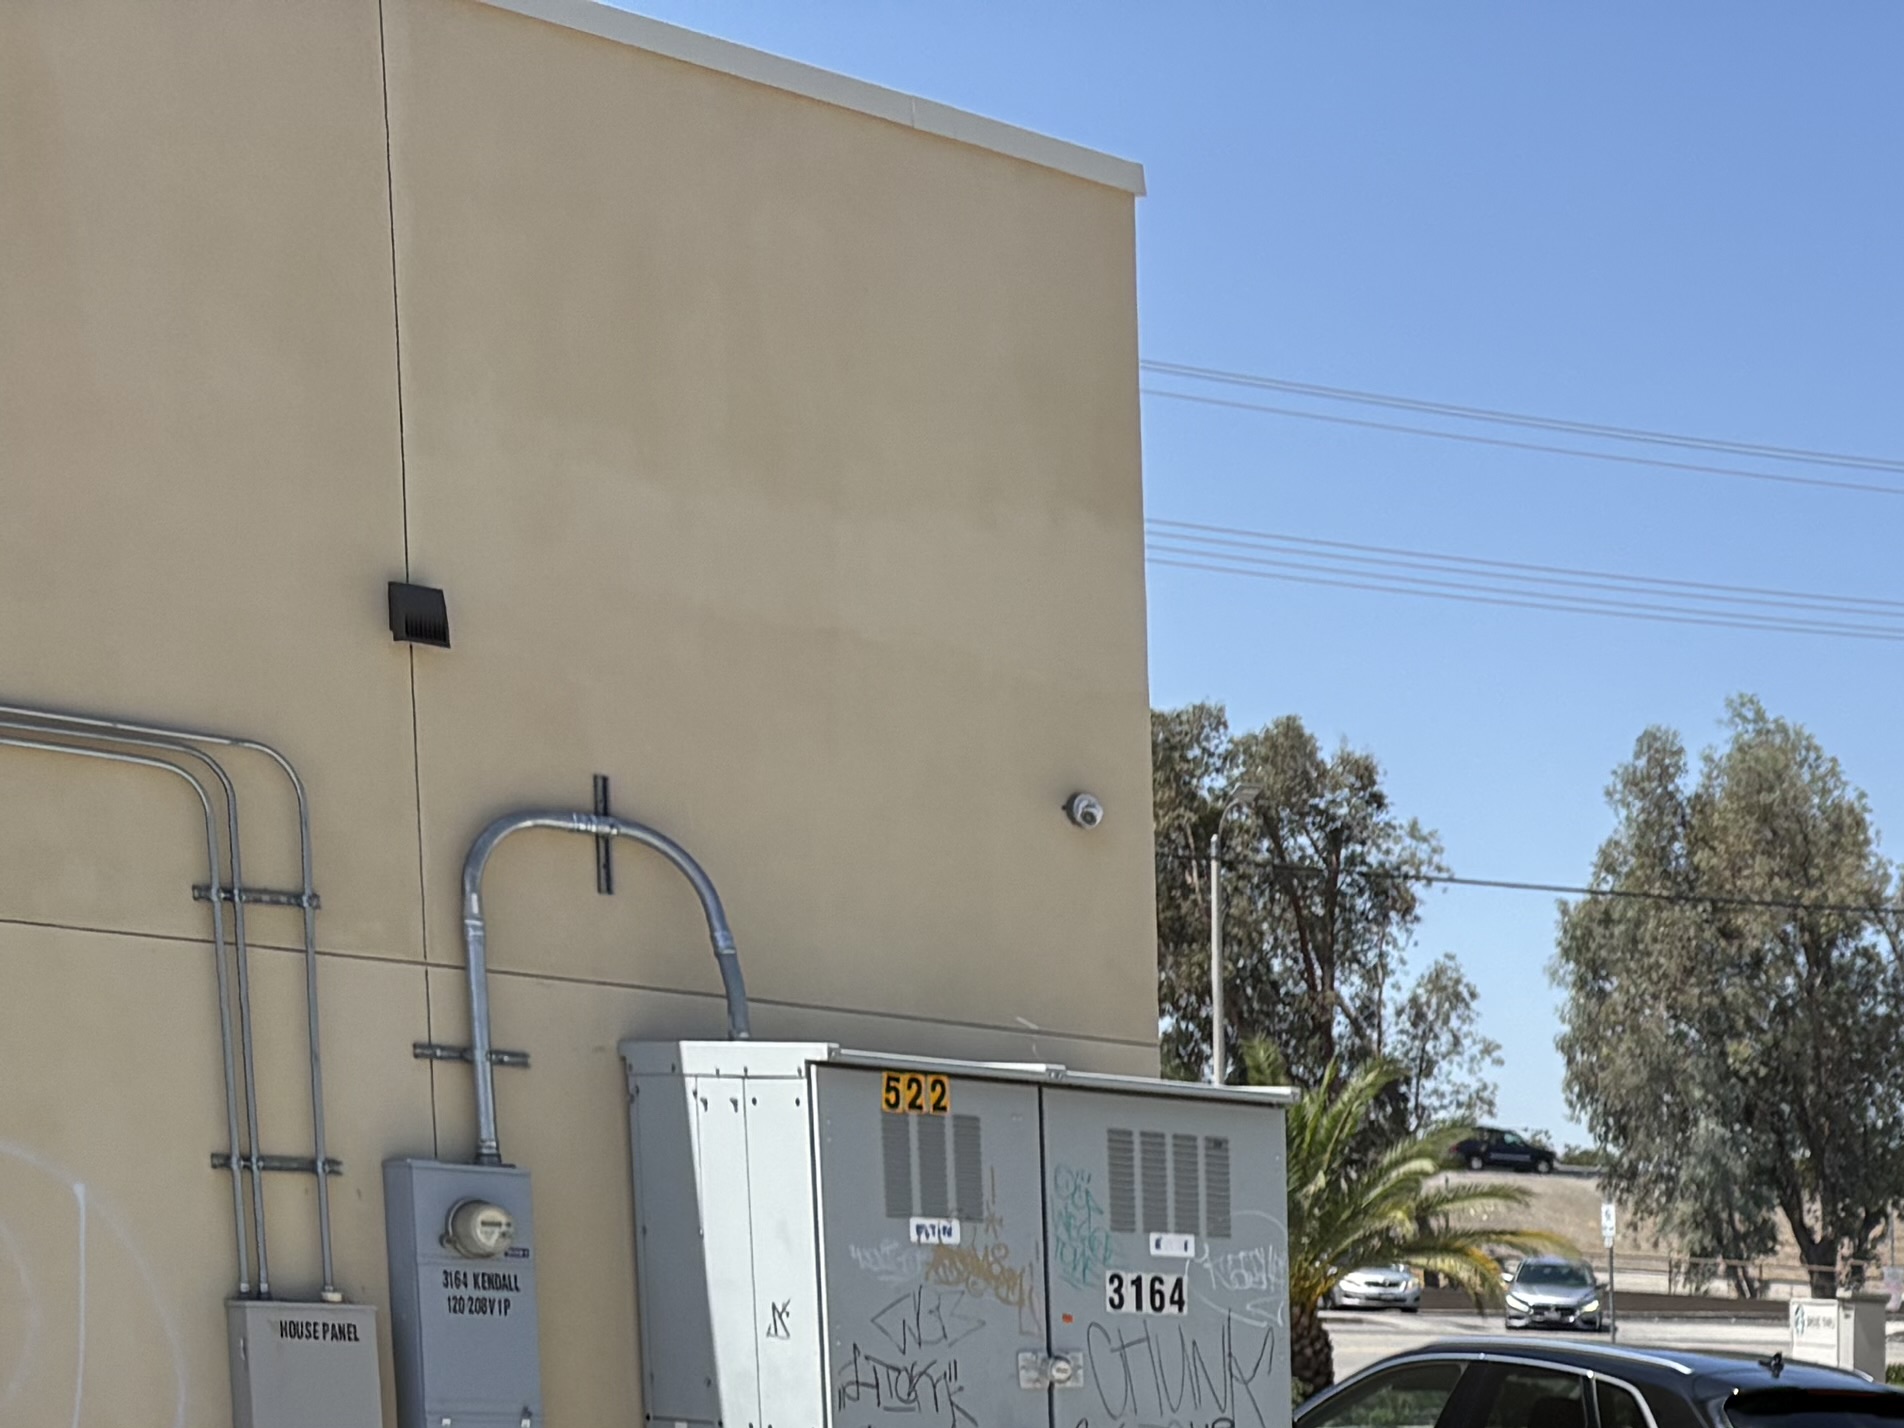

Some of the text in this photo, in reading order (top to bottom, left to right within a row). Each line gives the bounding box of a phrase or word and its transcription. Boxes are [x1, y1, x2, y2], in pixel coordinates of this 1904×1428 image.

[884, 1075, 948, 1112] 522
[442, 1269, 520, 1292] 3164 KENDALL
[1108, 1273, 1185, 1313] 3164
[280, 1320, 360, 1342] HOUSE PANEL
